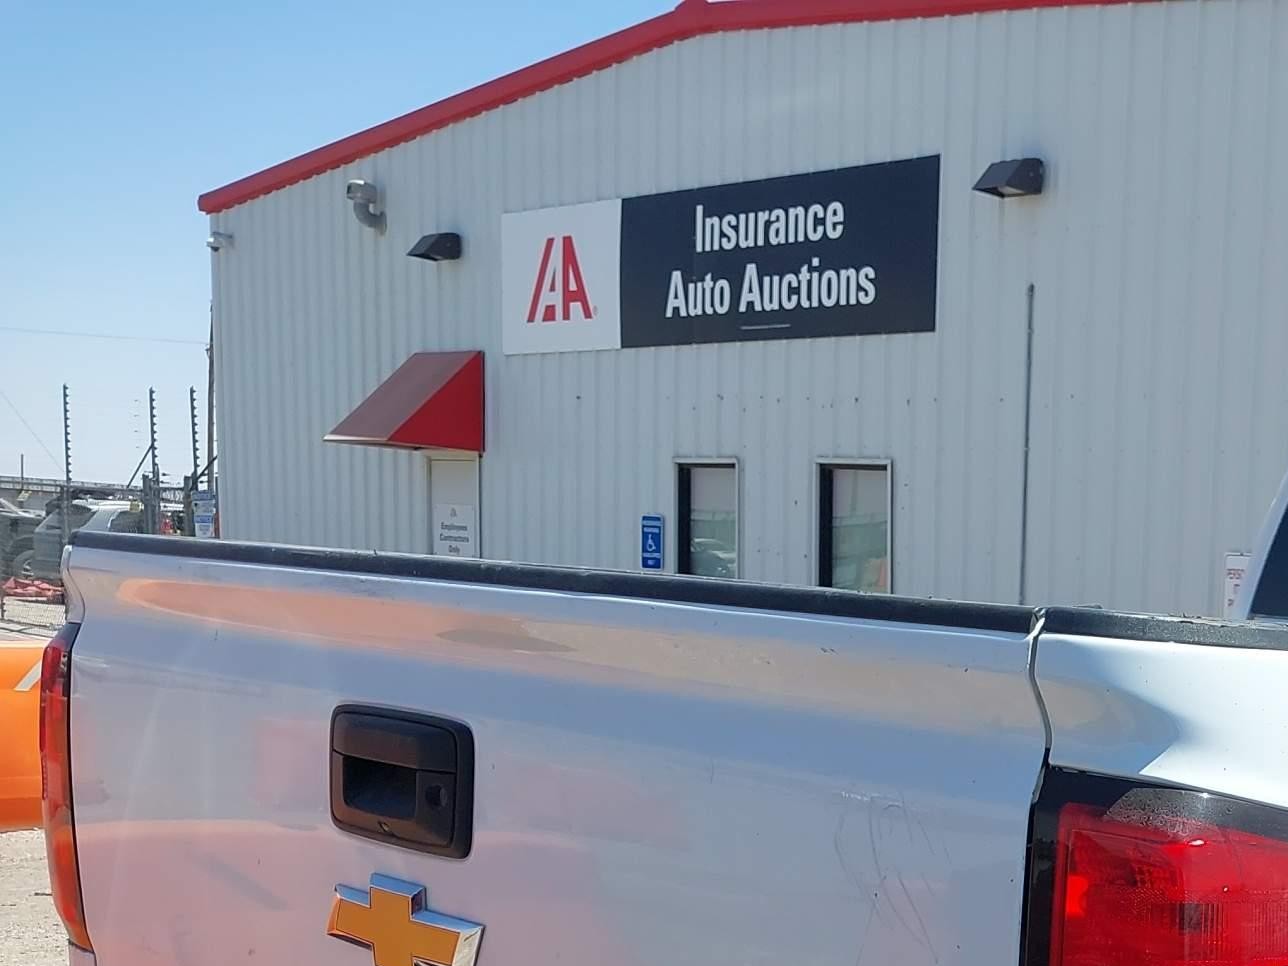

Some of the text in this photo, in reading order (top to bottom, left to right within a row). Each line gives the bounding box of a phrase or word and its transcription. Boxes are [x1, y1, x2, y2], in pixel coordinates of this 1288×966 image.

[694, 200, 845, 253] Insurance
[665, 257, 876, 318] Auto Auctions
